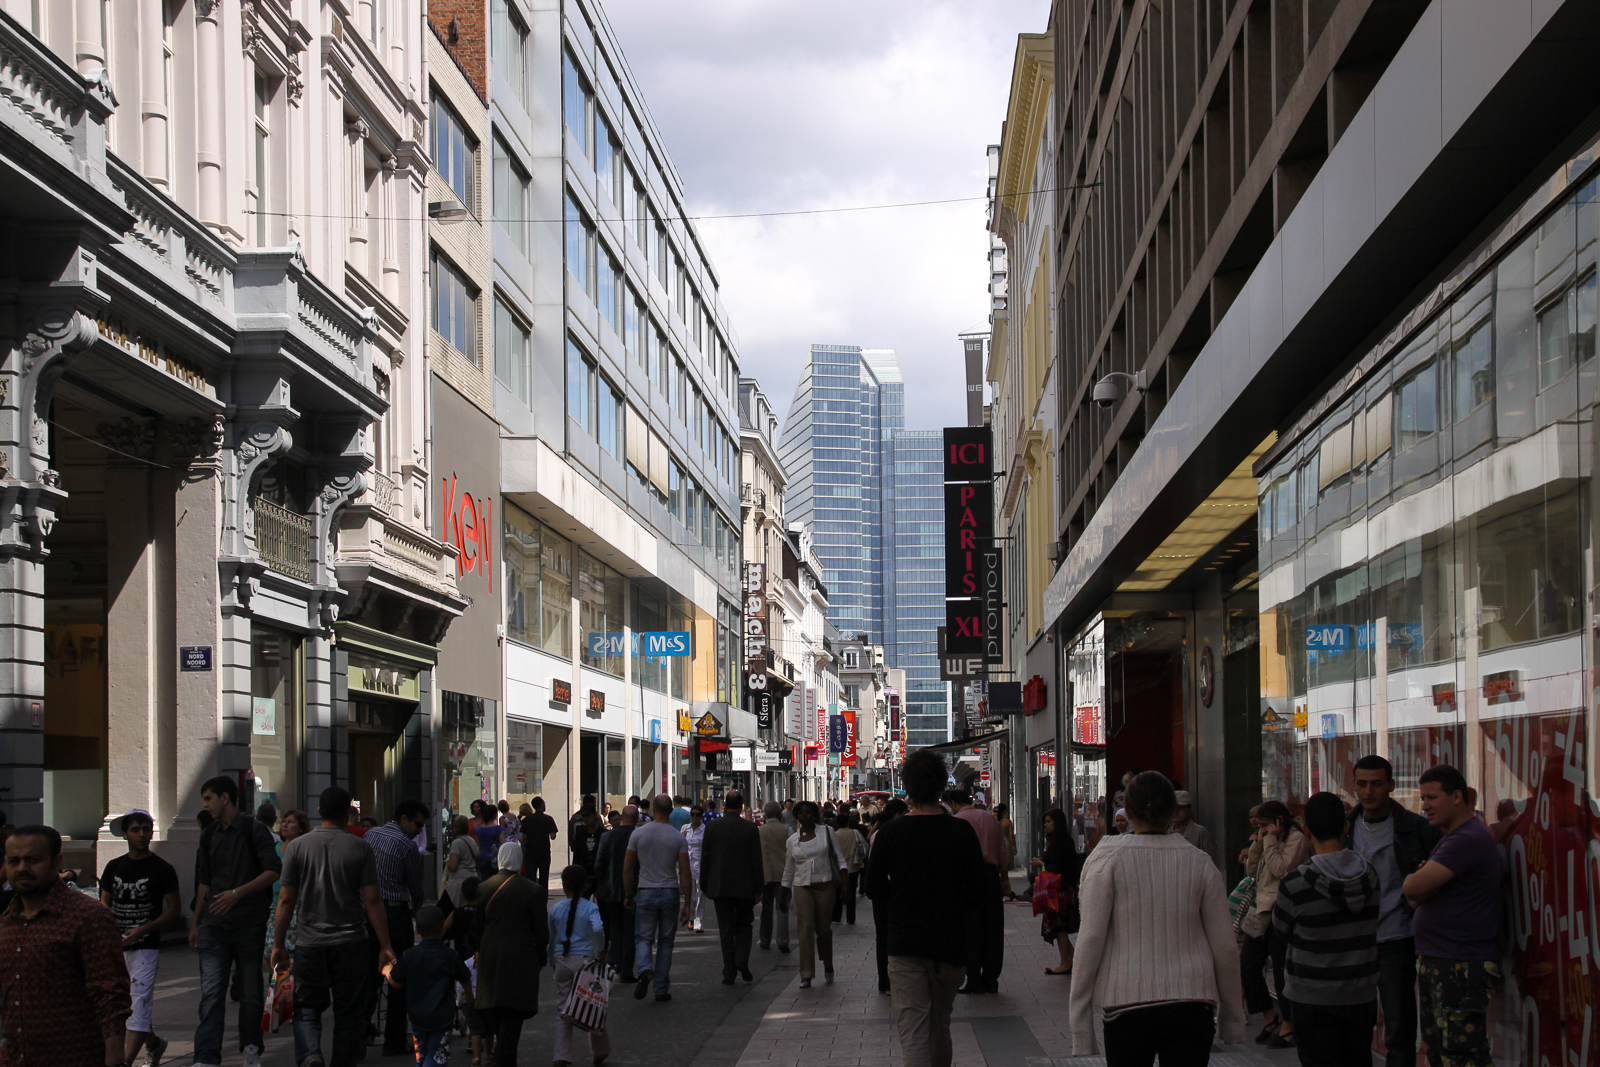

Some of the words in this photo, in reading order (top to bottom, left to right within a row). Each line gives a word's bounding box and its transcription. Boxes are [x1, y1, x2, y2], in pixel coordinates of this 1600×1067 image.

[951, 443, 985, 464] ICI
[960, 486, 977, 594] PARIS
[748, 564, 766, 657] mach
[984, 553, 1001, 658] promod
[955, 616, 983, 637] XL
[649, 635, 685, 653] M&S
[946, 659, 982, 675] WE
[749, 674, 766, 690] 3
